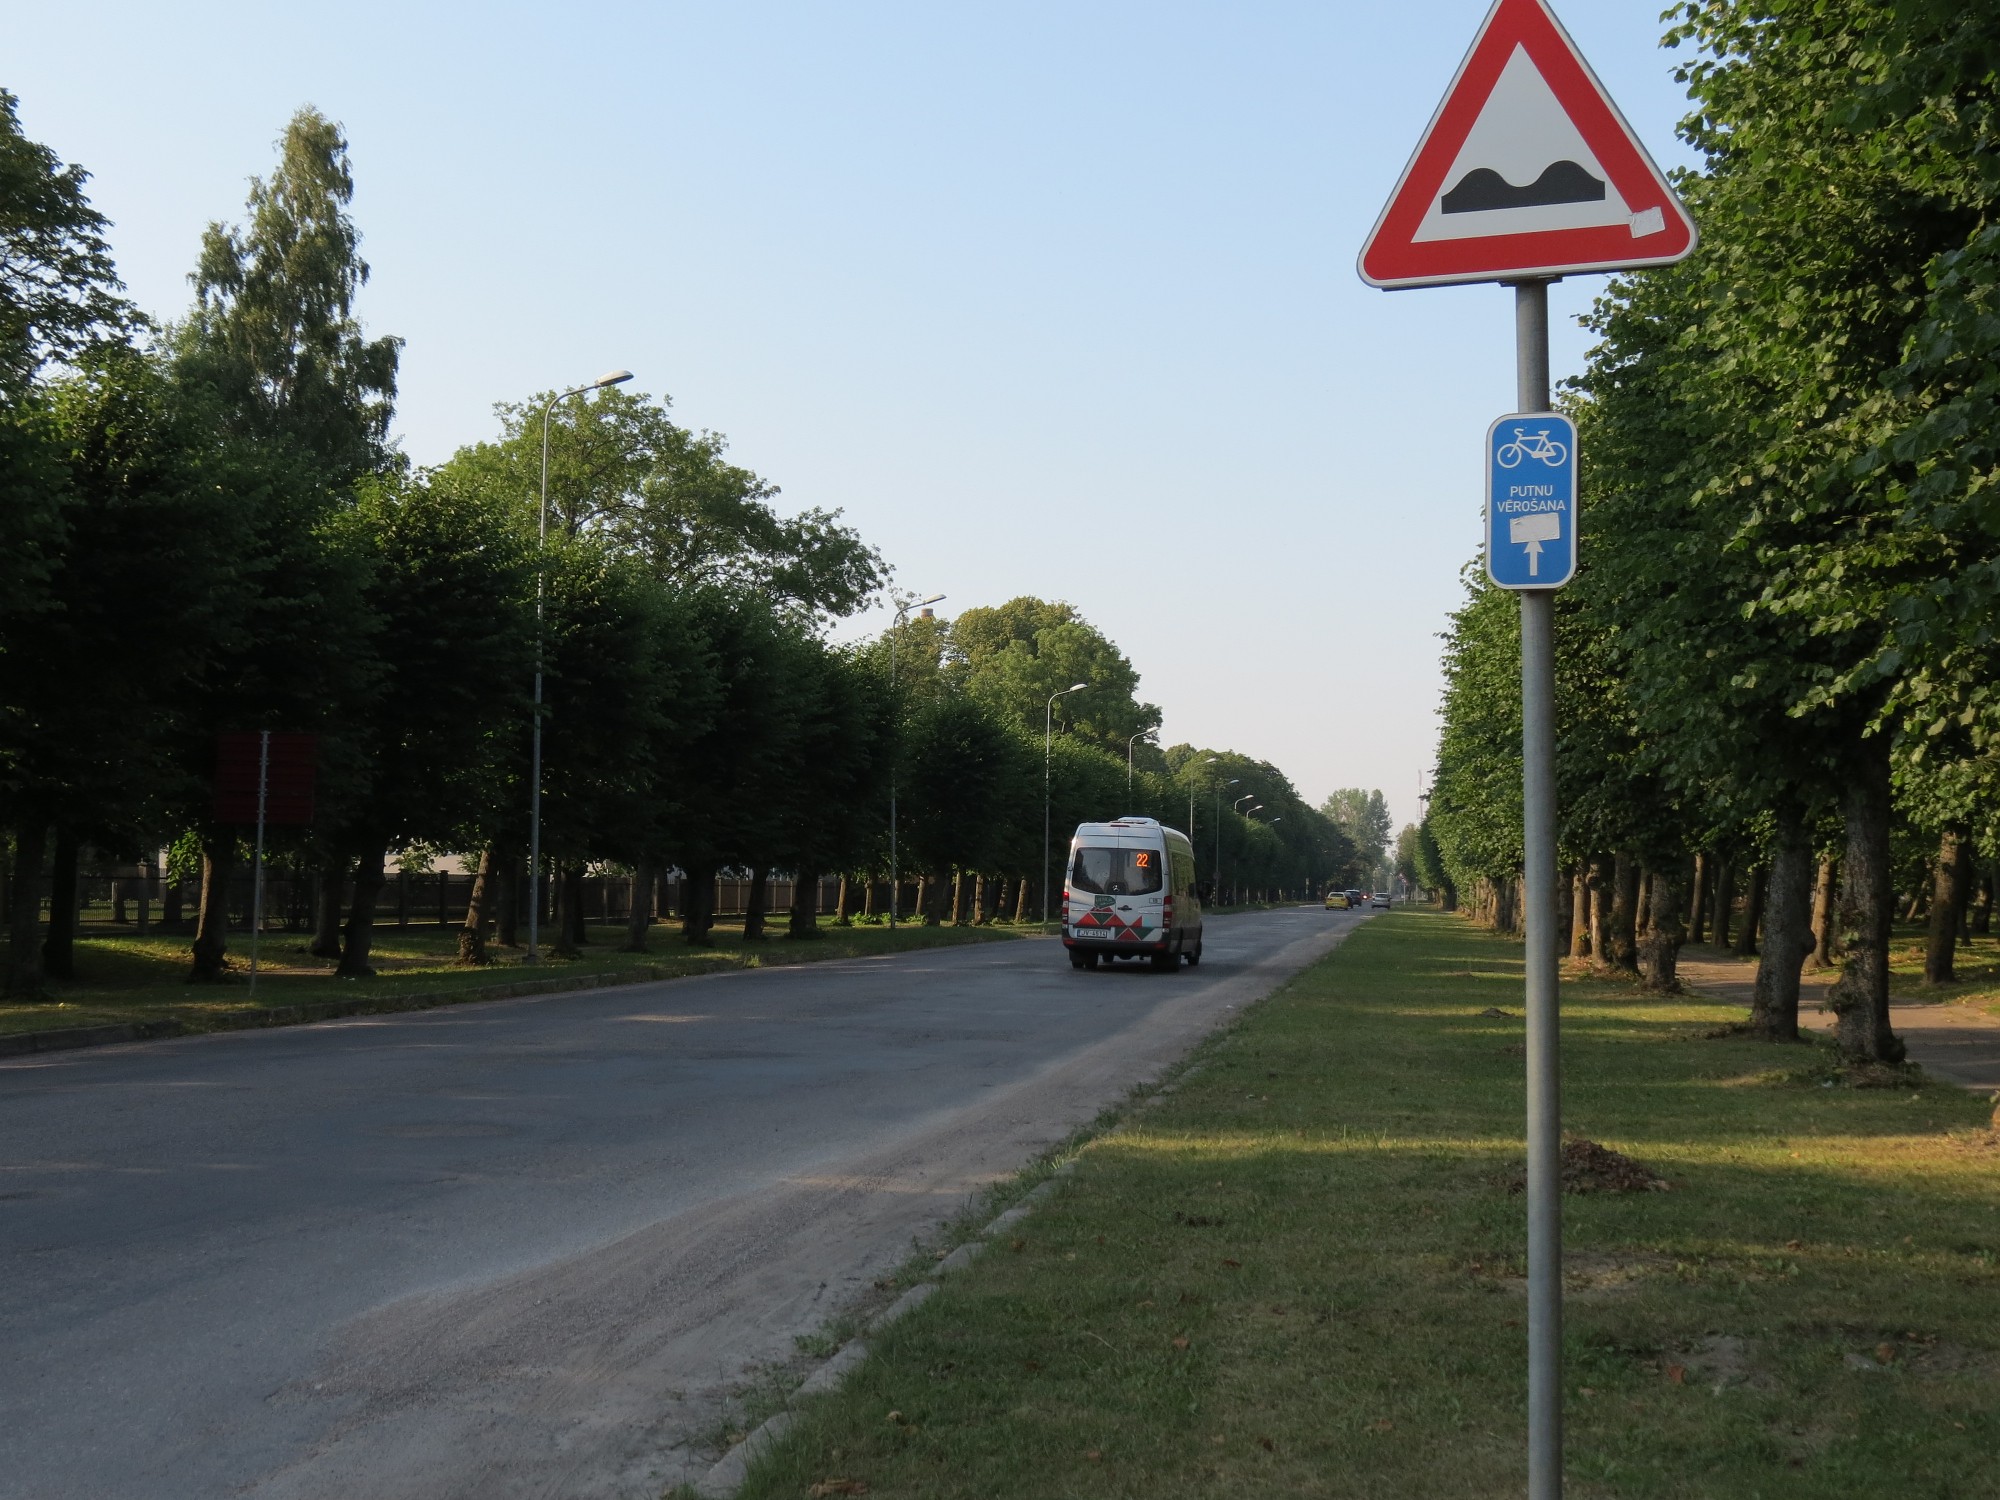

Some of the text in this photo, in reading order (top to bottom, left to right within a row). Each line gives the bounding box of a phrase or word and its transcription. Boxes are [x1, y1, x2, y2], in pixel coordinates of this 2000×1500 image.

[1510, 484, 1553, 497] PUTNU
[1497, 498, 1566, 513] VĒROŠANA
[1136, 853, 1148, 867] 22
